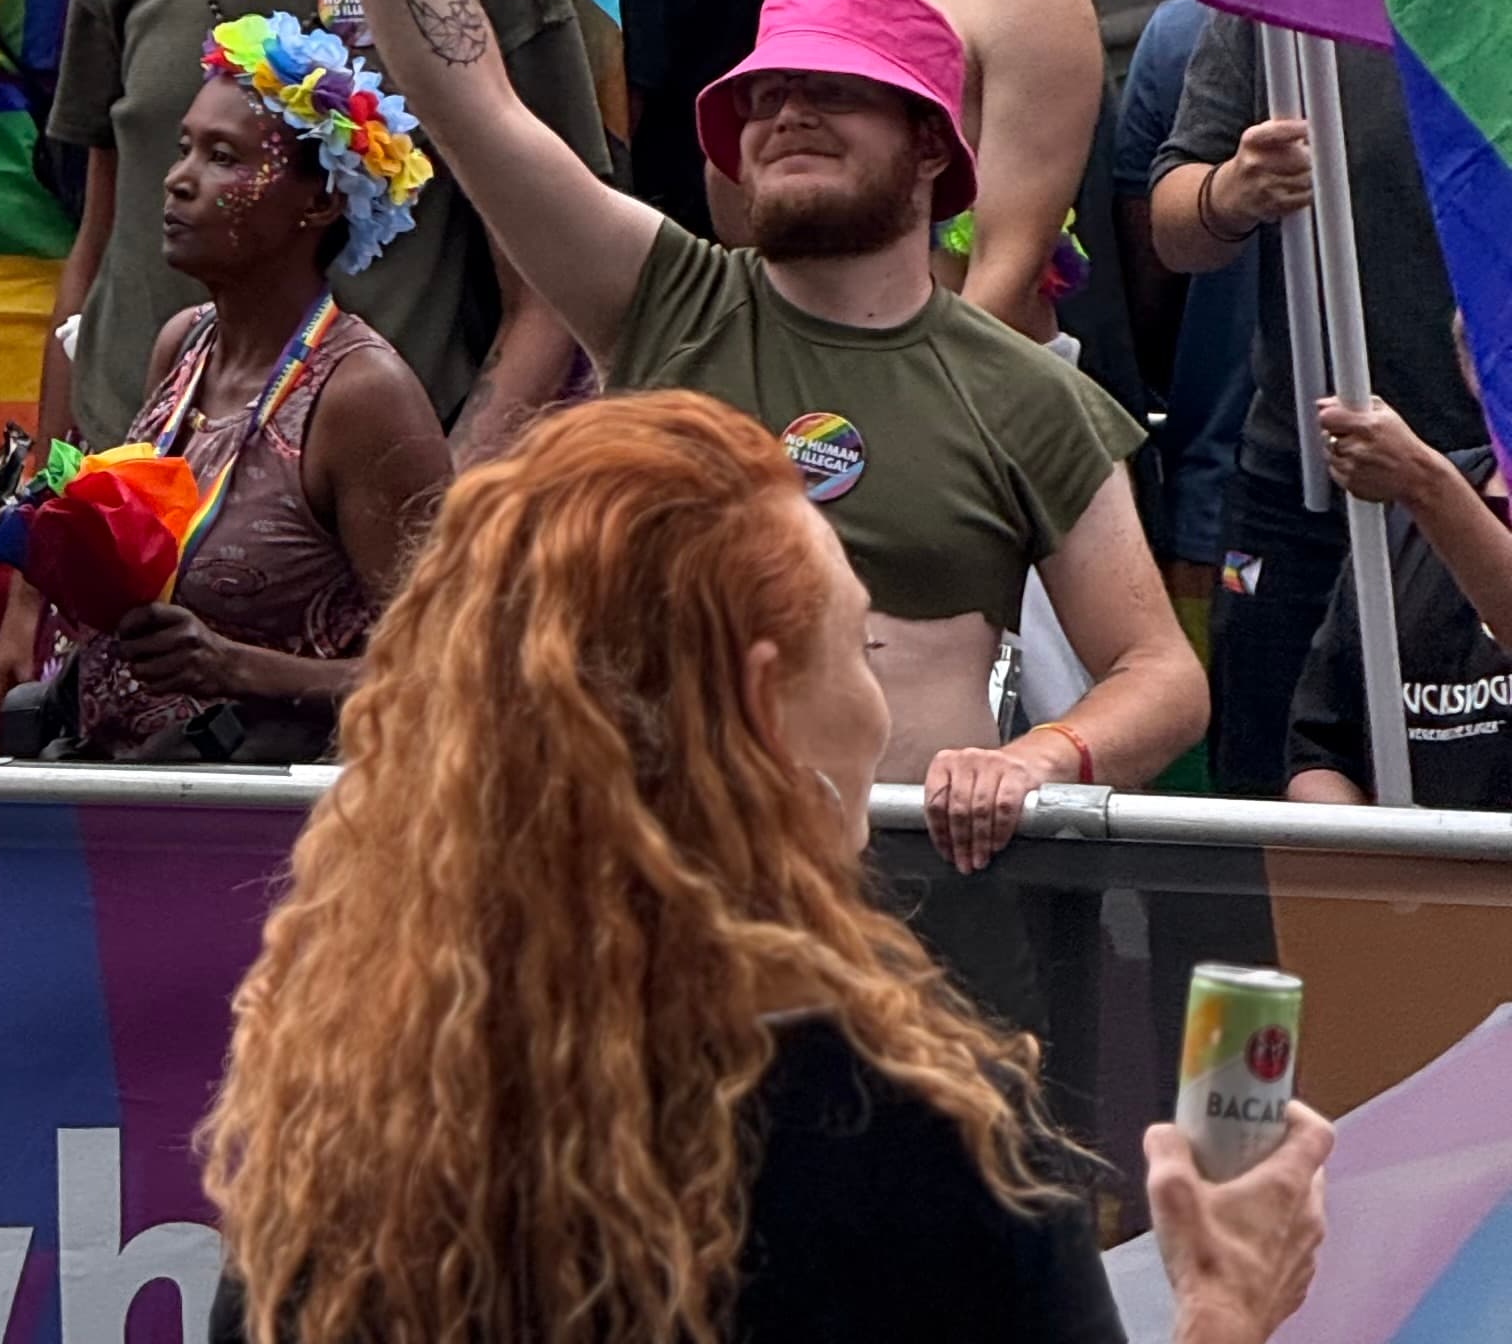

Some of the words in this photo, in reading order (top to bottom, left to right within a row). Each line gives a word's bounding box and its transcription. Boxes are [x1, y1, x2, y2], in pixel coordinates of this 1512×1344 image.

[785, 433, 806, 447] NO
[808, 440, 859, 463] HUMAN
[801, 450, 849, 472] ILLEGAL
